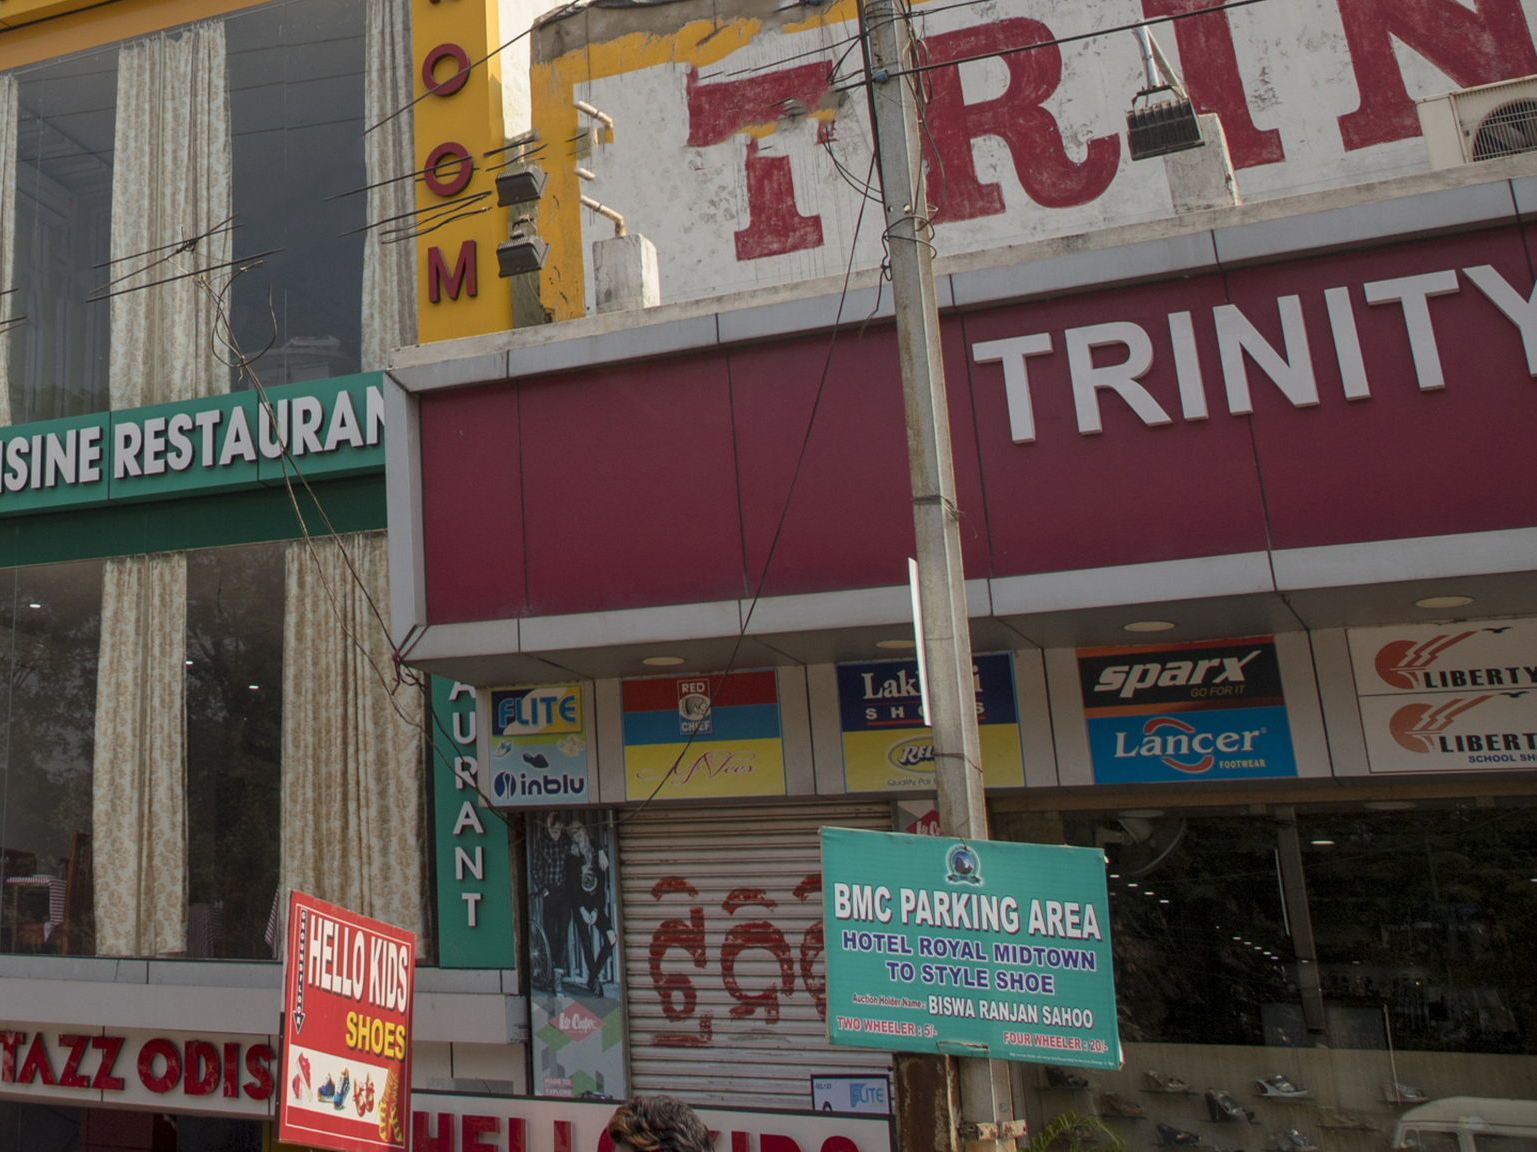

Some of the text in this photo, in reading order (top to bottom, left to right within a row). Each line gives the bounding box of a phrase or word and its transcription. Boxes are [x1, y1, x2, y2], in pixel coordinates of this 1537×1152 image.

[971, 263, 1537, 444] TRINITY
[680, 681, 706, 694] RED
[860, 664, 984, 700] Laki
[1093, 650, 1262, 698] sparx
[1423, 666, 1537, 689] LIBERTY
[1190, 684, 1246, 698] GO FOR IT
[497, 694, 577, 729] FLITE
[681, 719, 711, 733] CHIEF
[1113, 729, 1261, 759] Lancer
[1468, 753, 1517, 764] SCHOOL
[1218, 758, 1267, 770] FOOTWEAR
[520, 772, 585, 797] inblu
[833, 882, 1103, 941] BMC PARKING AREA
[307, 914, 409, 1014] HELLO KIDS
[842, 930, 1097, 972] HOTEL ROYAL MIDTOWN
[885, 960, 1056, 995] TO STYLE SHOE
[836, 1016, 861, 1031] TWO
[863, 1018, 916, 1037] WHEELER
[928, 995, 976, 1019] BISWA
[979, 999, 1038, 1025] RANJAN
[1042, 1005, 1094, 1030] SAHOO
[345, 1010, 406, 1061] SHOES
[1003, 1031, 1031, 1046] FOUR
[1034, 1033, 1081, 1051] WHEELER
